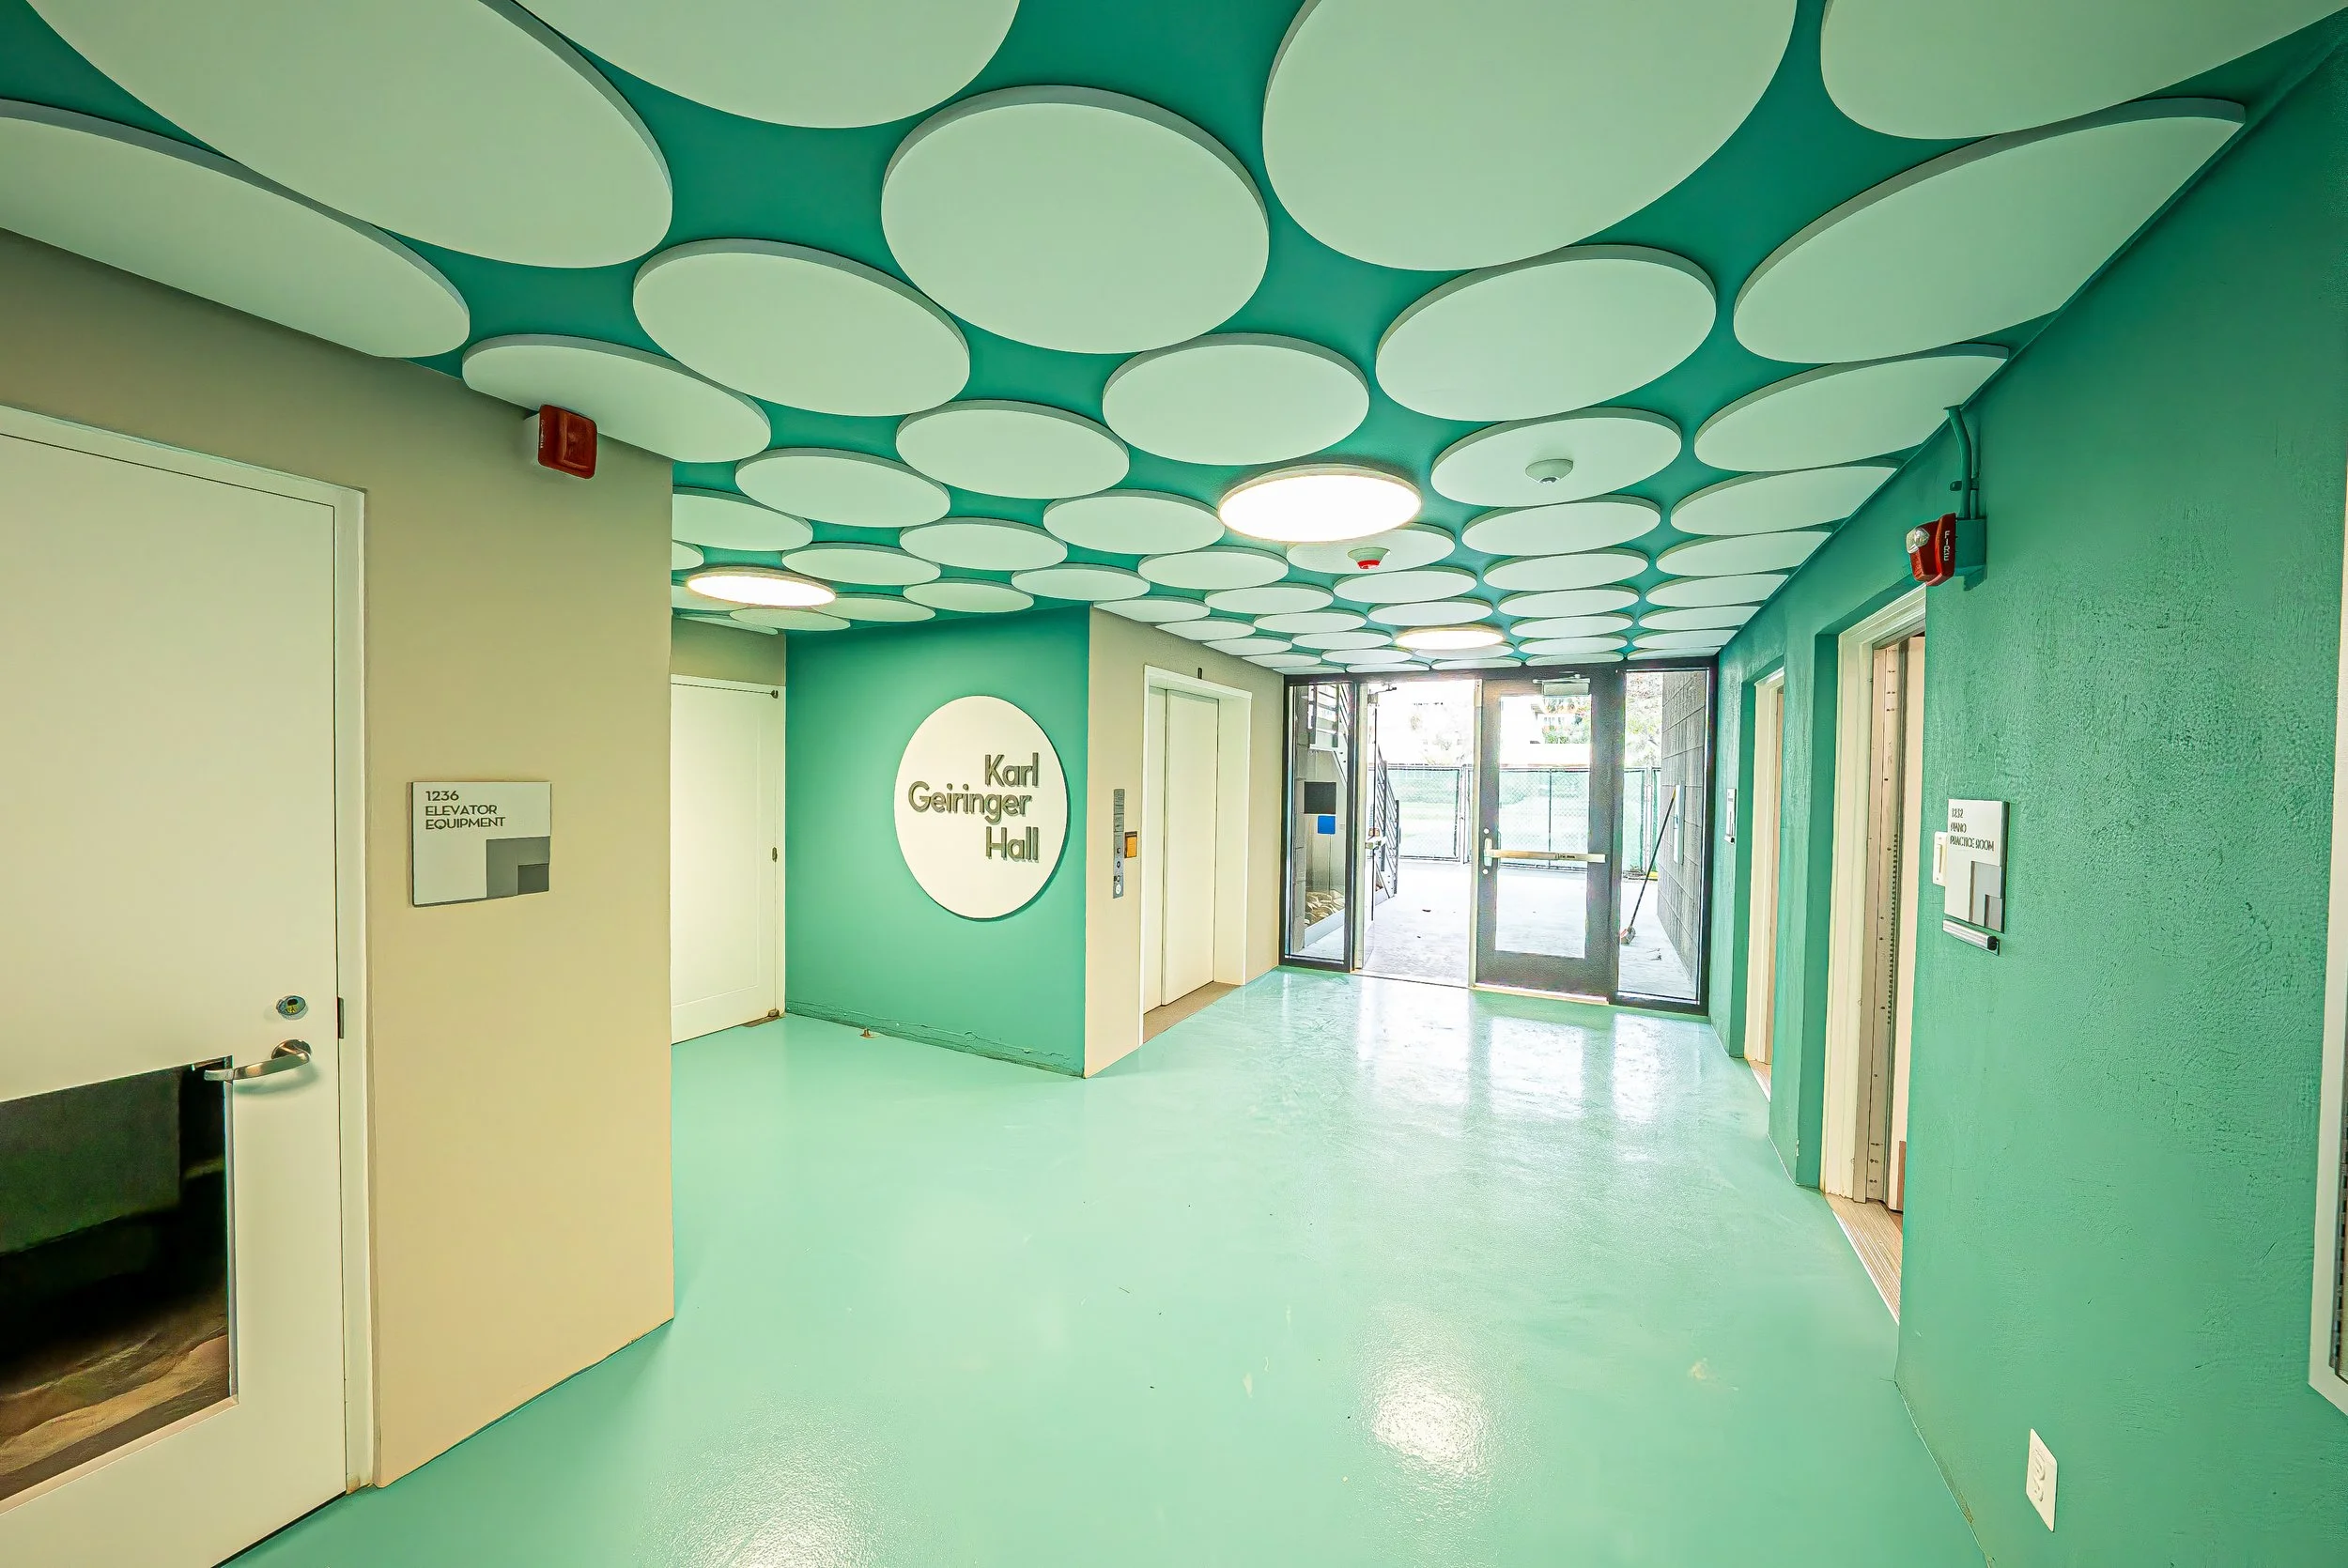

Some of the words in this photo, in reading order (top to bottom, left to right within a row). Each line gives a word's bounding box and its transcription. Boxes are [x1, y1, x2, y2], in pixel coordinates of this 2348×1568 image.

[985, 752, 1040, 787] Karl
[425, 791, 459, 801] 1236
[908, 781, 1032, 824] Geiringer
[425, 805, 498, 816] ELEVATOR
[425, 817, 506, 830] EQUIPMENT
[1950, 822, 1968, 833] PIANO
[985, 826, 1040, 863] Hall
[1950, 835, 1975, 849] PRACTICE
[1975, 838, 1995, 852] ROOM
